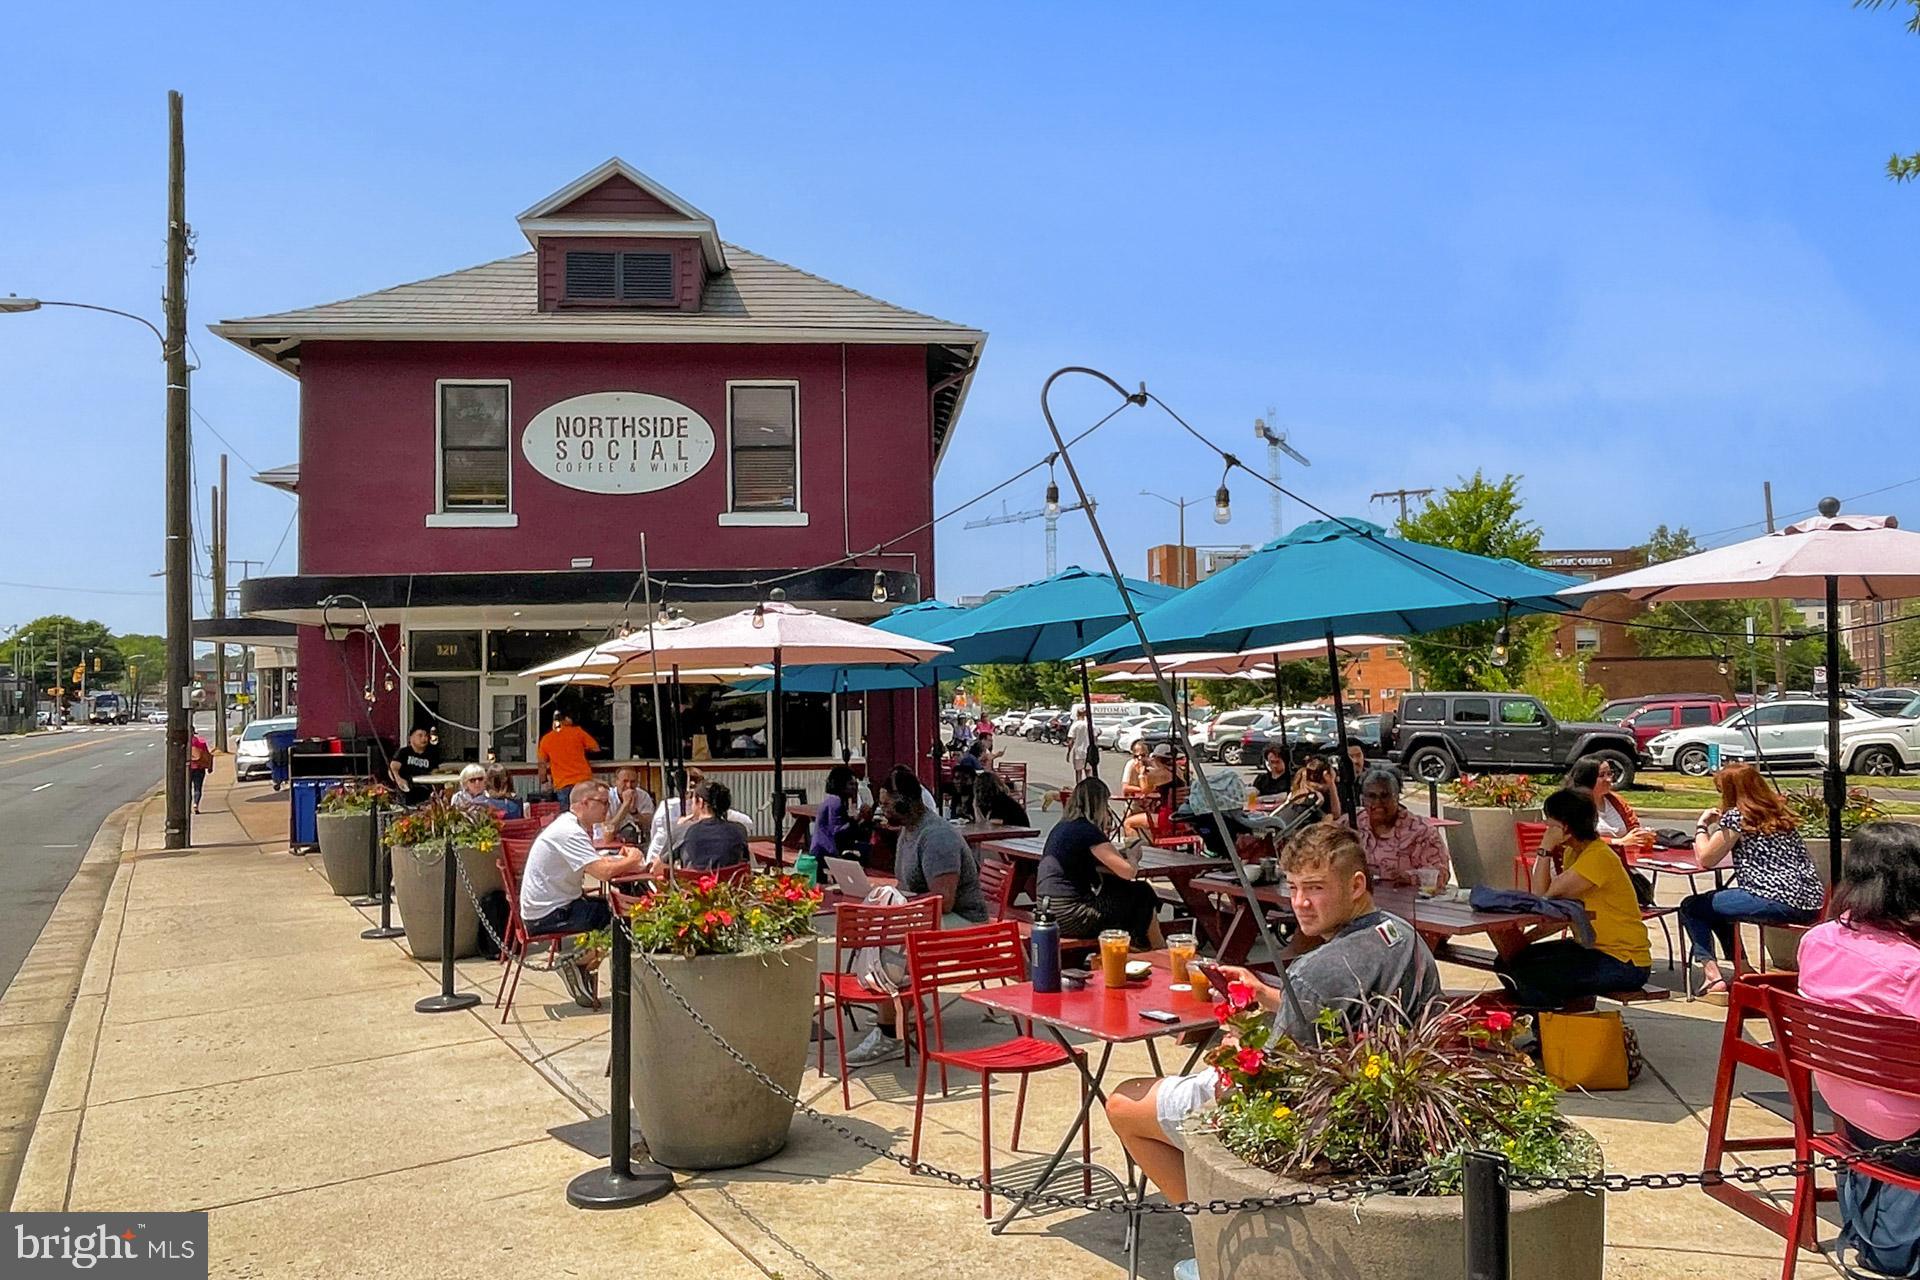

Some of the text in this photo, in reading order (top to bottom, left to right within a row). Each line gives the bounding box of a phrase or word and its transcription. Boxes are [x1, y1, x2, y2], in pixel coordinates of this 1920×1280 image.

[556, 416, 689, 438] NORTHSIDE
[556, 440, 689, 461] SOCIAL
[556, 462, 689, 473] COFFEE & WINE
